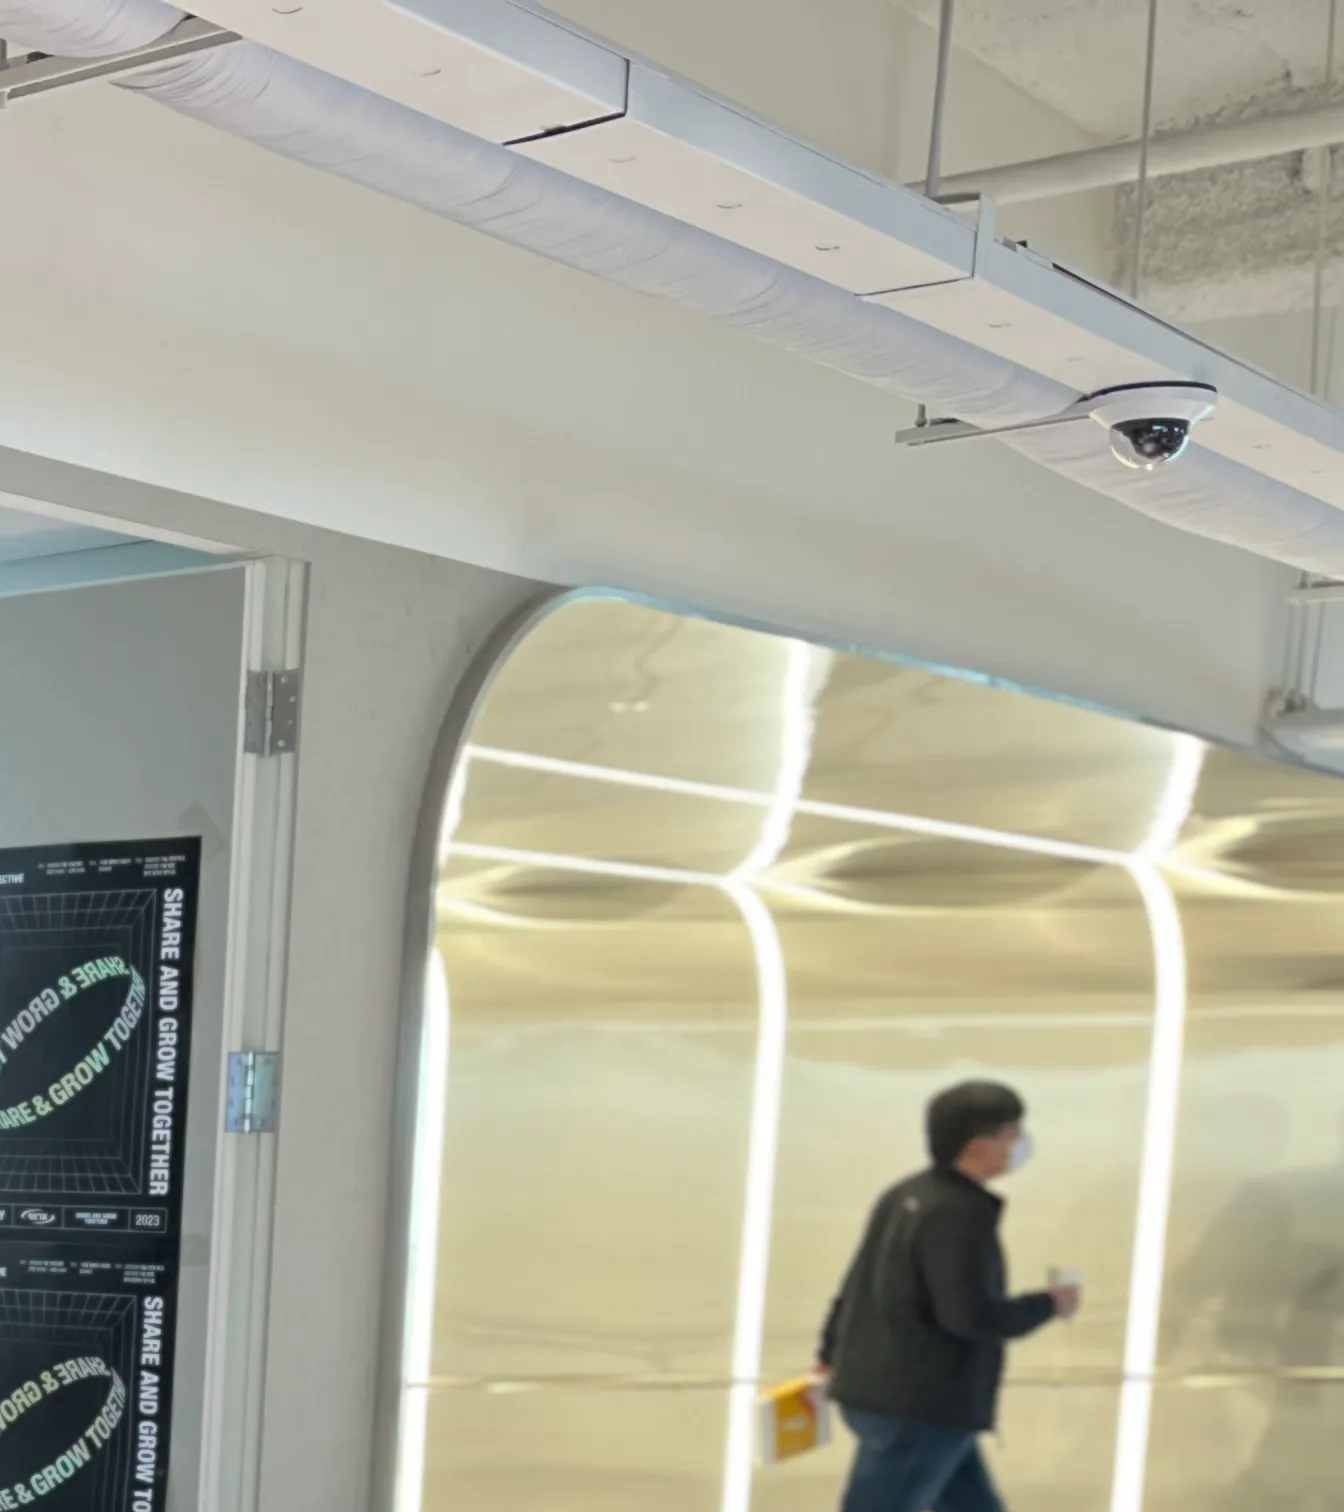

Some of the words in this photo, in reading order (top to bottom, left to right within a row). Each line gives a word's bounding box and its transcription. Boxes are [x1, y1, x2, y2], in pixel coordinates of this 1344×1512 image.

[162, 888, 181, 959] SHARE
[159, 965, 178, 1010] AND
[156, 1017, 177, 1080] GROW
[150, 1087, 172, 1194] TOGETHER
[135, 1214, 159, 1225] 2023
[142, 1297, 161, 1365] SHARE
[139, 1370, 158, 1414] AND
[136, 1421, 157, 1482] GROW
